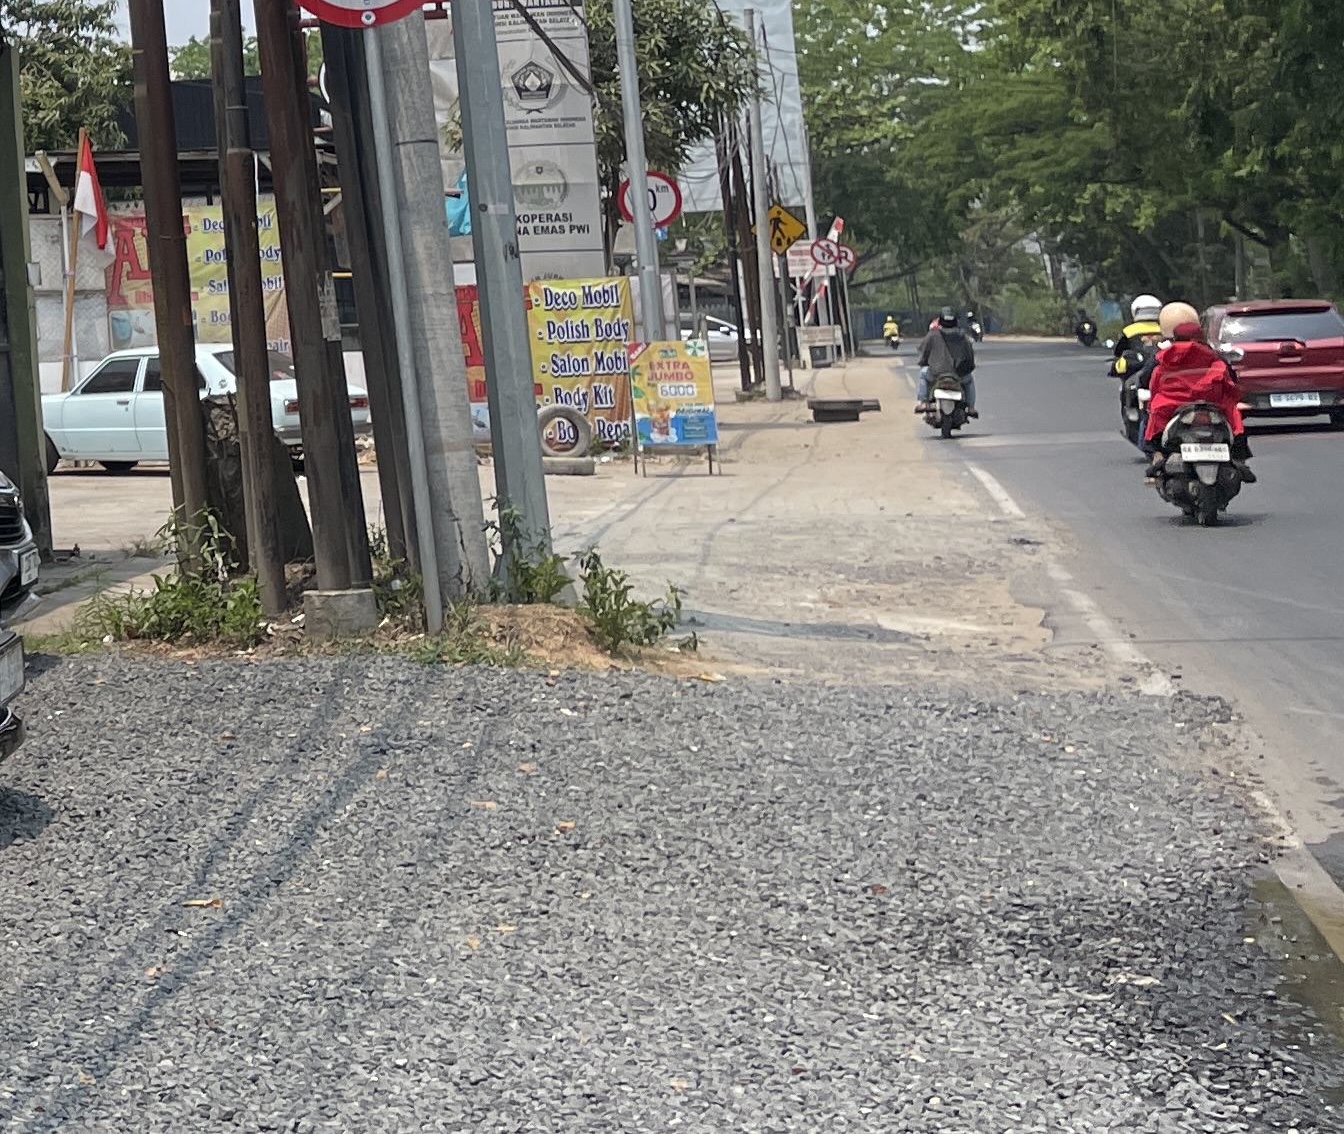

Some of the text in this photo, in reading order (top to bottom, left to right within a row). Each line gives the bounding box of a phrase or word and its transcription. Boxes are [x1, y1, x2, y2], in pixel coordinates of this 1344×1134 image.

[534, 224, 566, 236] EMAS
[569, 223, 590, 235] PWI
[544, 284, 620, 306] Deco Mobil
[547, 319, 629, 342] Polish Body
[551, 353, 589, 374] Salon
[594, 351, 628, 372] Mobi
[649, 361, 690, 371] EXTRA
[648, 371, 695, 382] JUMBO
[554, 385, 615, 412] Body Kit
